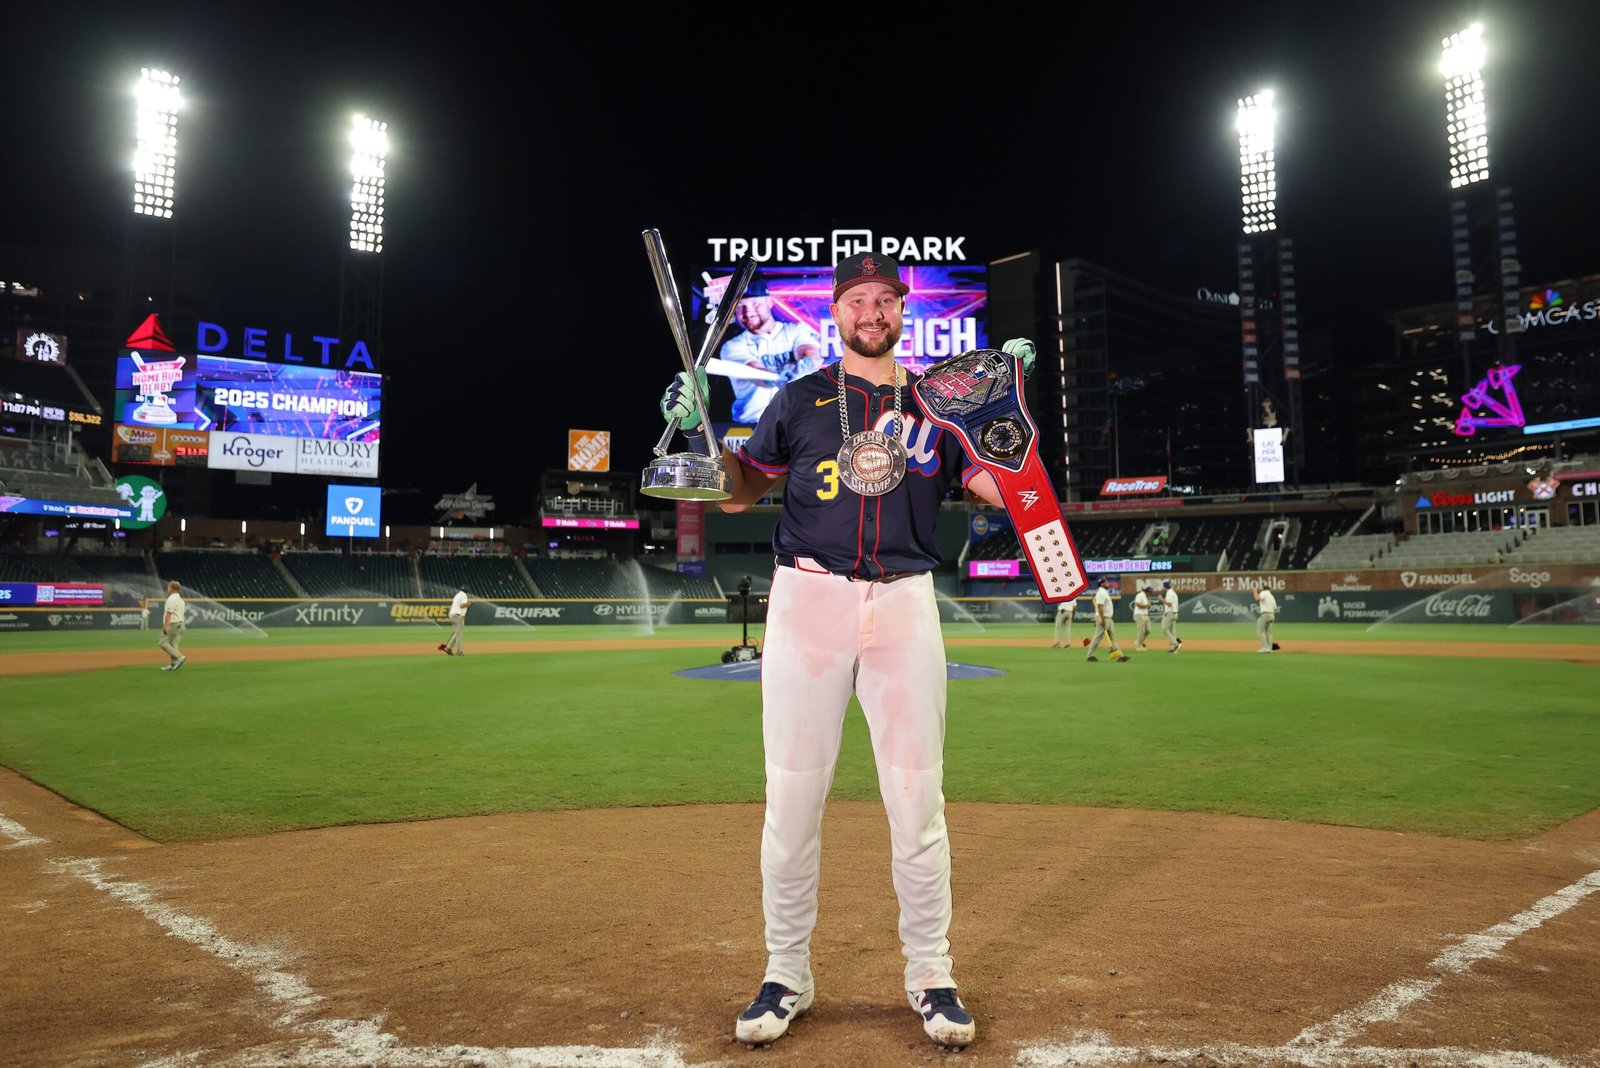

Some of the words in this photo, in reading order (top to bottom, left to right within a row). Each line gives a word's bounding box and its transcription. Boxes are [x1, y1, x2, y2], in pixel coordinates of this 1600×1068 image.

[707, 238, 825, 262] TRUIST
[880, 237, 967, 261] PARK
[1487, 301, 1600, 334] CMCAS
[820, 317, 977, 356] REIGH
[197, 321, 375, 370] DELTA
[134, 373, 162, 383] HOME
[162, 371, 182, 381] RUN
[141, 383, 172, 394] DERBY
[3, 402, 26, 413] 11:07
[27, 405, 41, 416] PM
[214, 389, 270, 408] 2025
[272, 393, 368, 418] CHAMPION
[726, 439, 746, 451] NA
[853, 431, 890, 448] DERBY
[223, 439, 285, 470] Kroger
[302, 439, 375, 458] EMORY
[570, 431, 609, 470] HOME
[301, 457, 371, 469] HEALTHCARE
[851, 476, 892, 493] CHAMP
[1106, 480, 1159, 492] RaceTrac
[1571, 482, 1600, 497] CH
[1432, 492, 1475, 507] Coors
[1474, 489, 1516, 504] LIGHT
[331, 516, 376, 526] FANDUEL
[1085, 561, 1107, 572] HOME
[1108, 560, 1124, 571] RUN
[1124, 560, 1149, 571] DERBY
[1151, 562, 1172, 570] 2025
[1238, 577, 1286, 590] Mobile
[1419, 574, 1477, 585] FANDUEL
[1509, 568, 1551, 588] Sage
[201, 608, 264, 621] Wellstar
[295, 603, 364, 625] xfinity
[391, 604, 453, 617] QUIKRE
[495, 606, 561, 619] EQUIFAX
[1209, 602, 1248, 616] Georgia
[1251, 602, 1281, 613] Por
[1343, 610, 1390, 618] PERMANENTE
